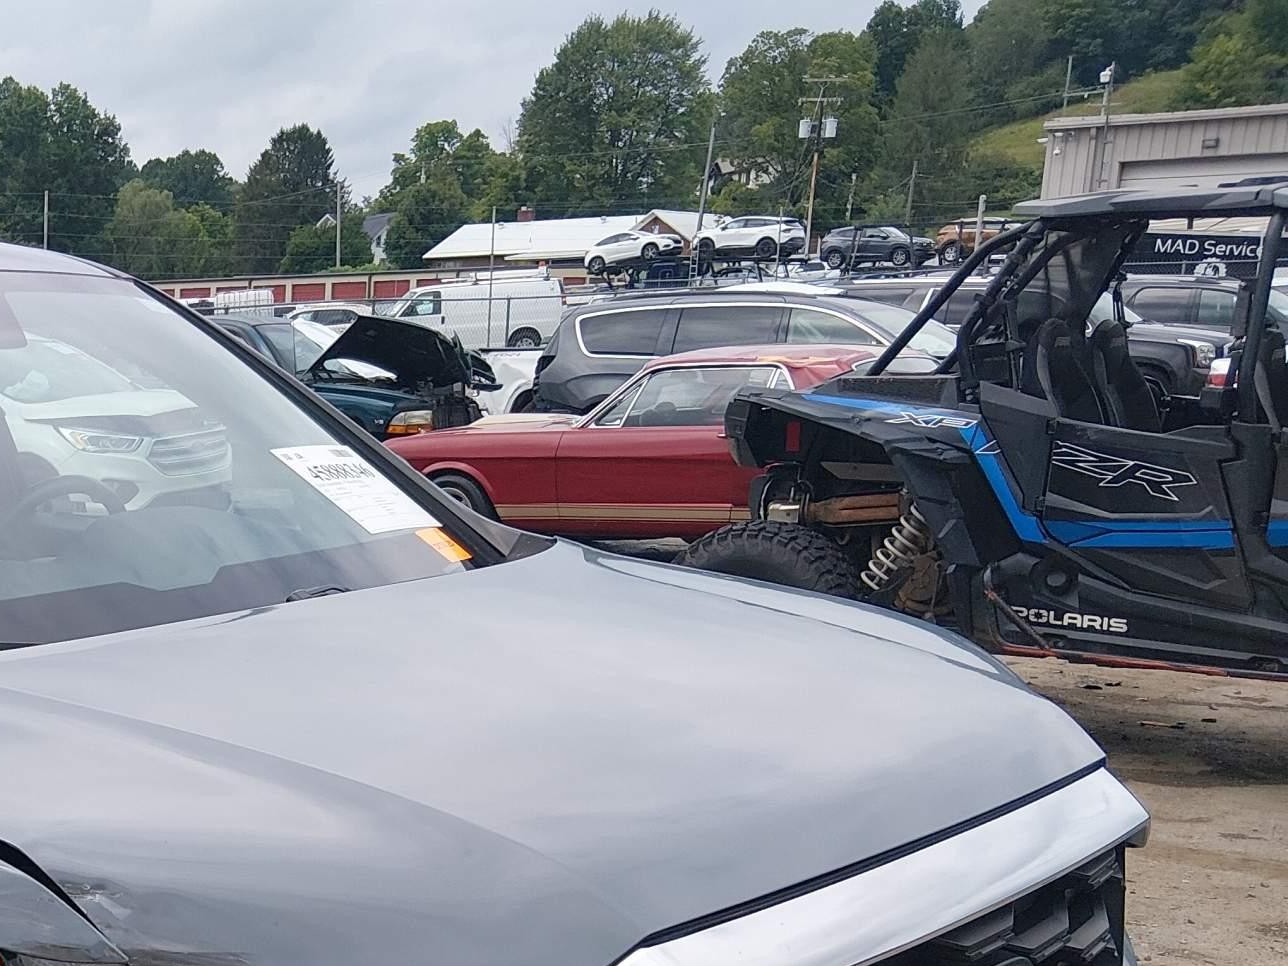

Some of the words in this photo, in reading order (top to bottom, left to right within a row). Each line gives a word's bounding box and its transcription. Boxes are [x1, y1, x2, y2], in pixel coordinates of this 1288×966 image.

[1154, 238, 1199, 255] MAD
[888, 411, 978, 428] XP
[306, 462, 376, 482] 45888346
[1010, 606, 1128, 633] POLARIS
